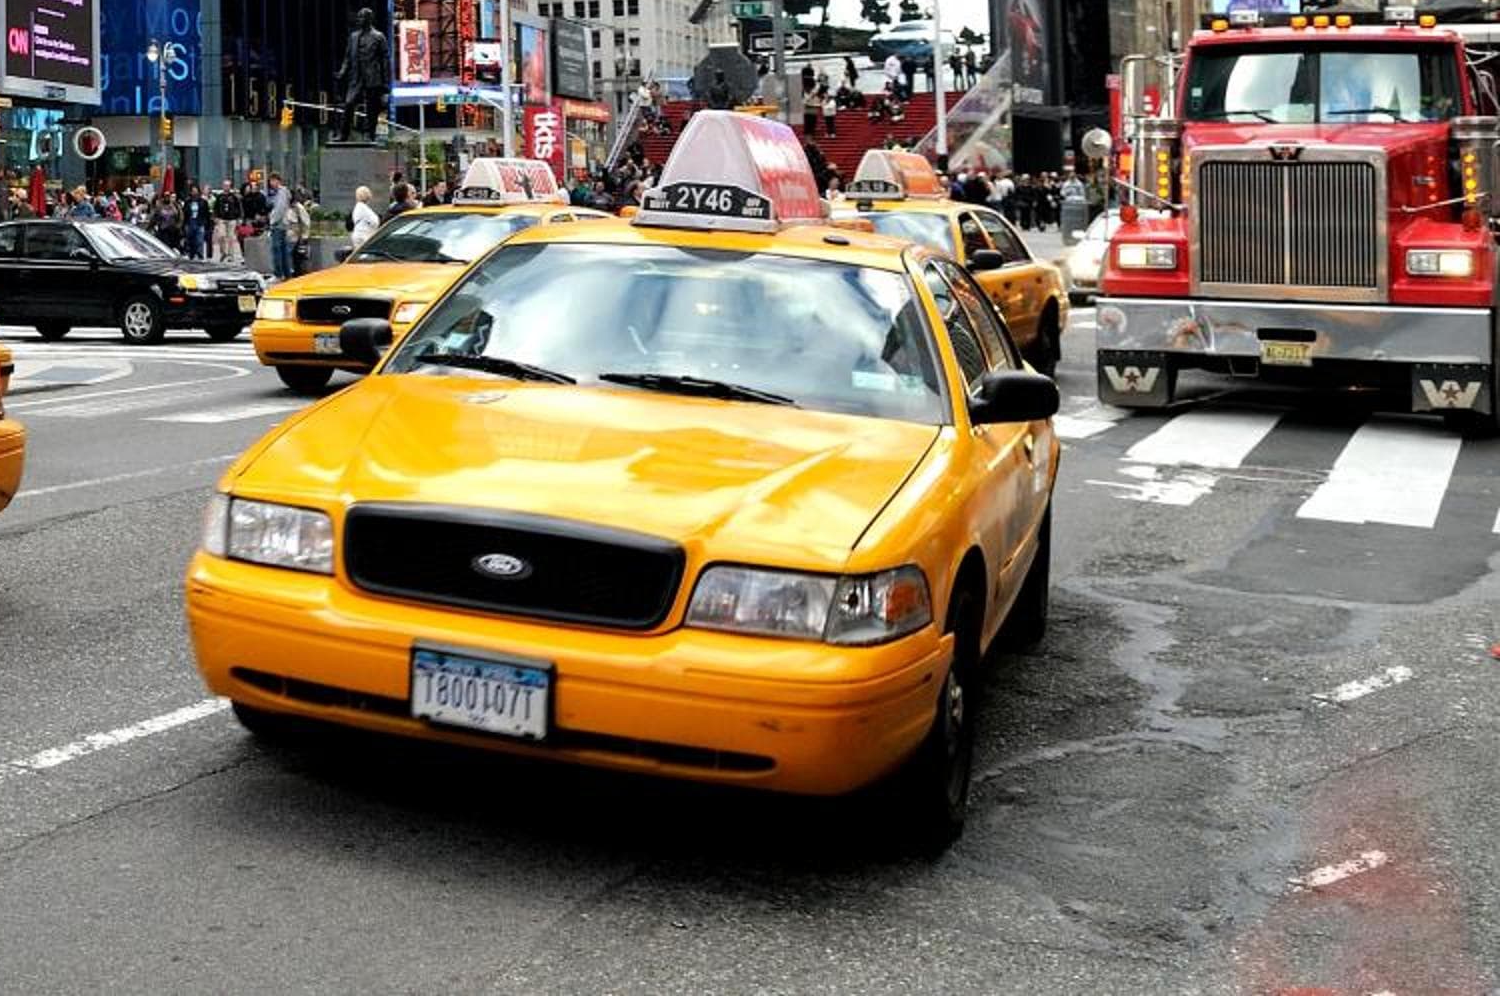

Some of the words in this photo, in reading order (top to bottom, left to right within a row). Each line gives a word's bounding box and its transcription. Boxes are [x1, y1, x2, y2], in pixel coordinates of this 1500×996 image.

[534, 111, 558, 159] tkts
[675, 185, 733, 212] 2Y46
[421, 671, 534, 722] T800107T
